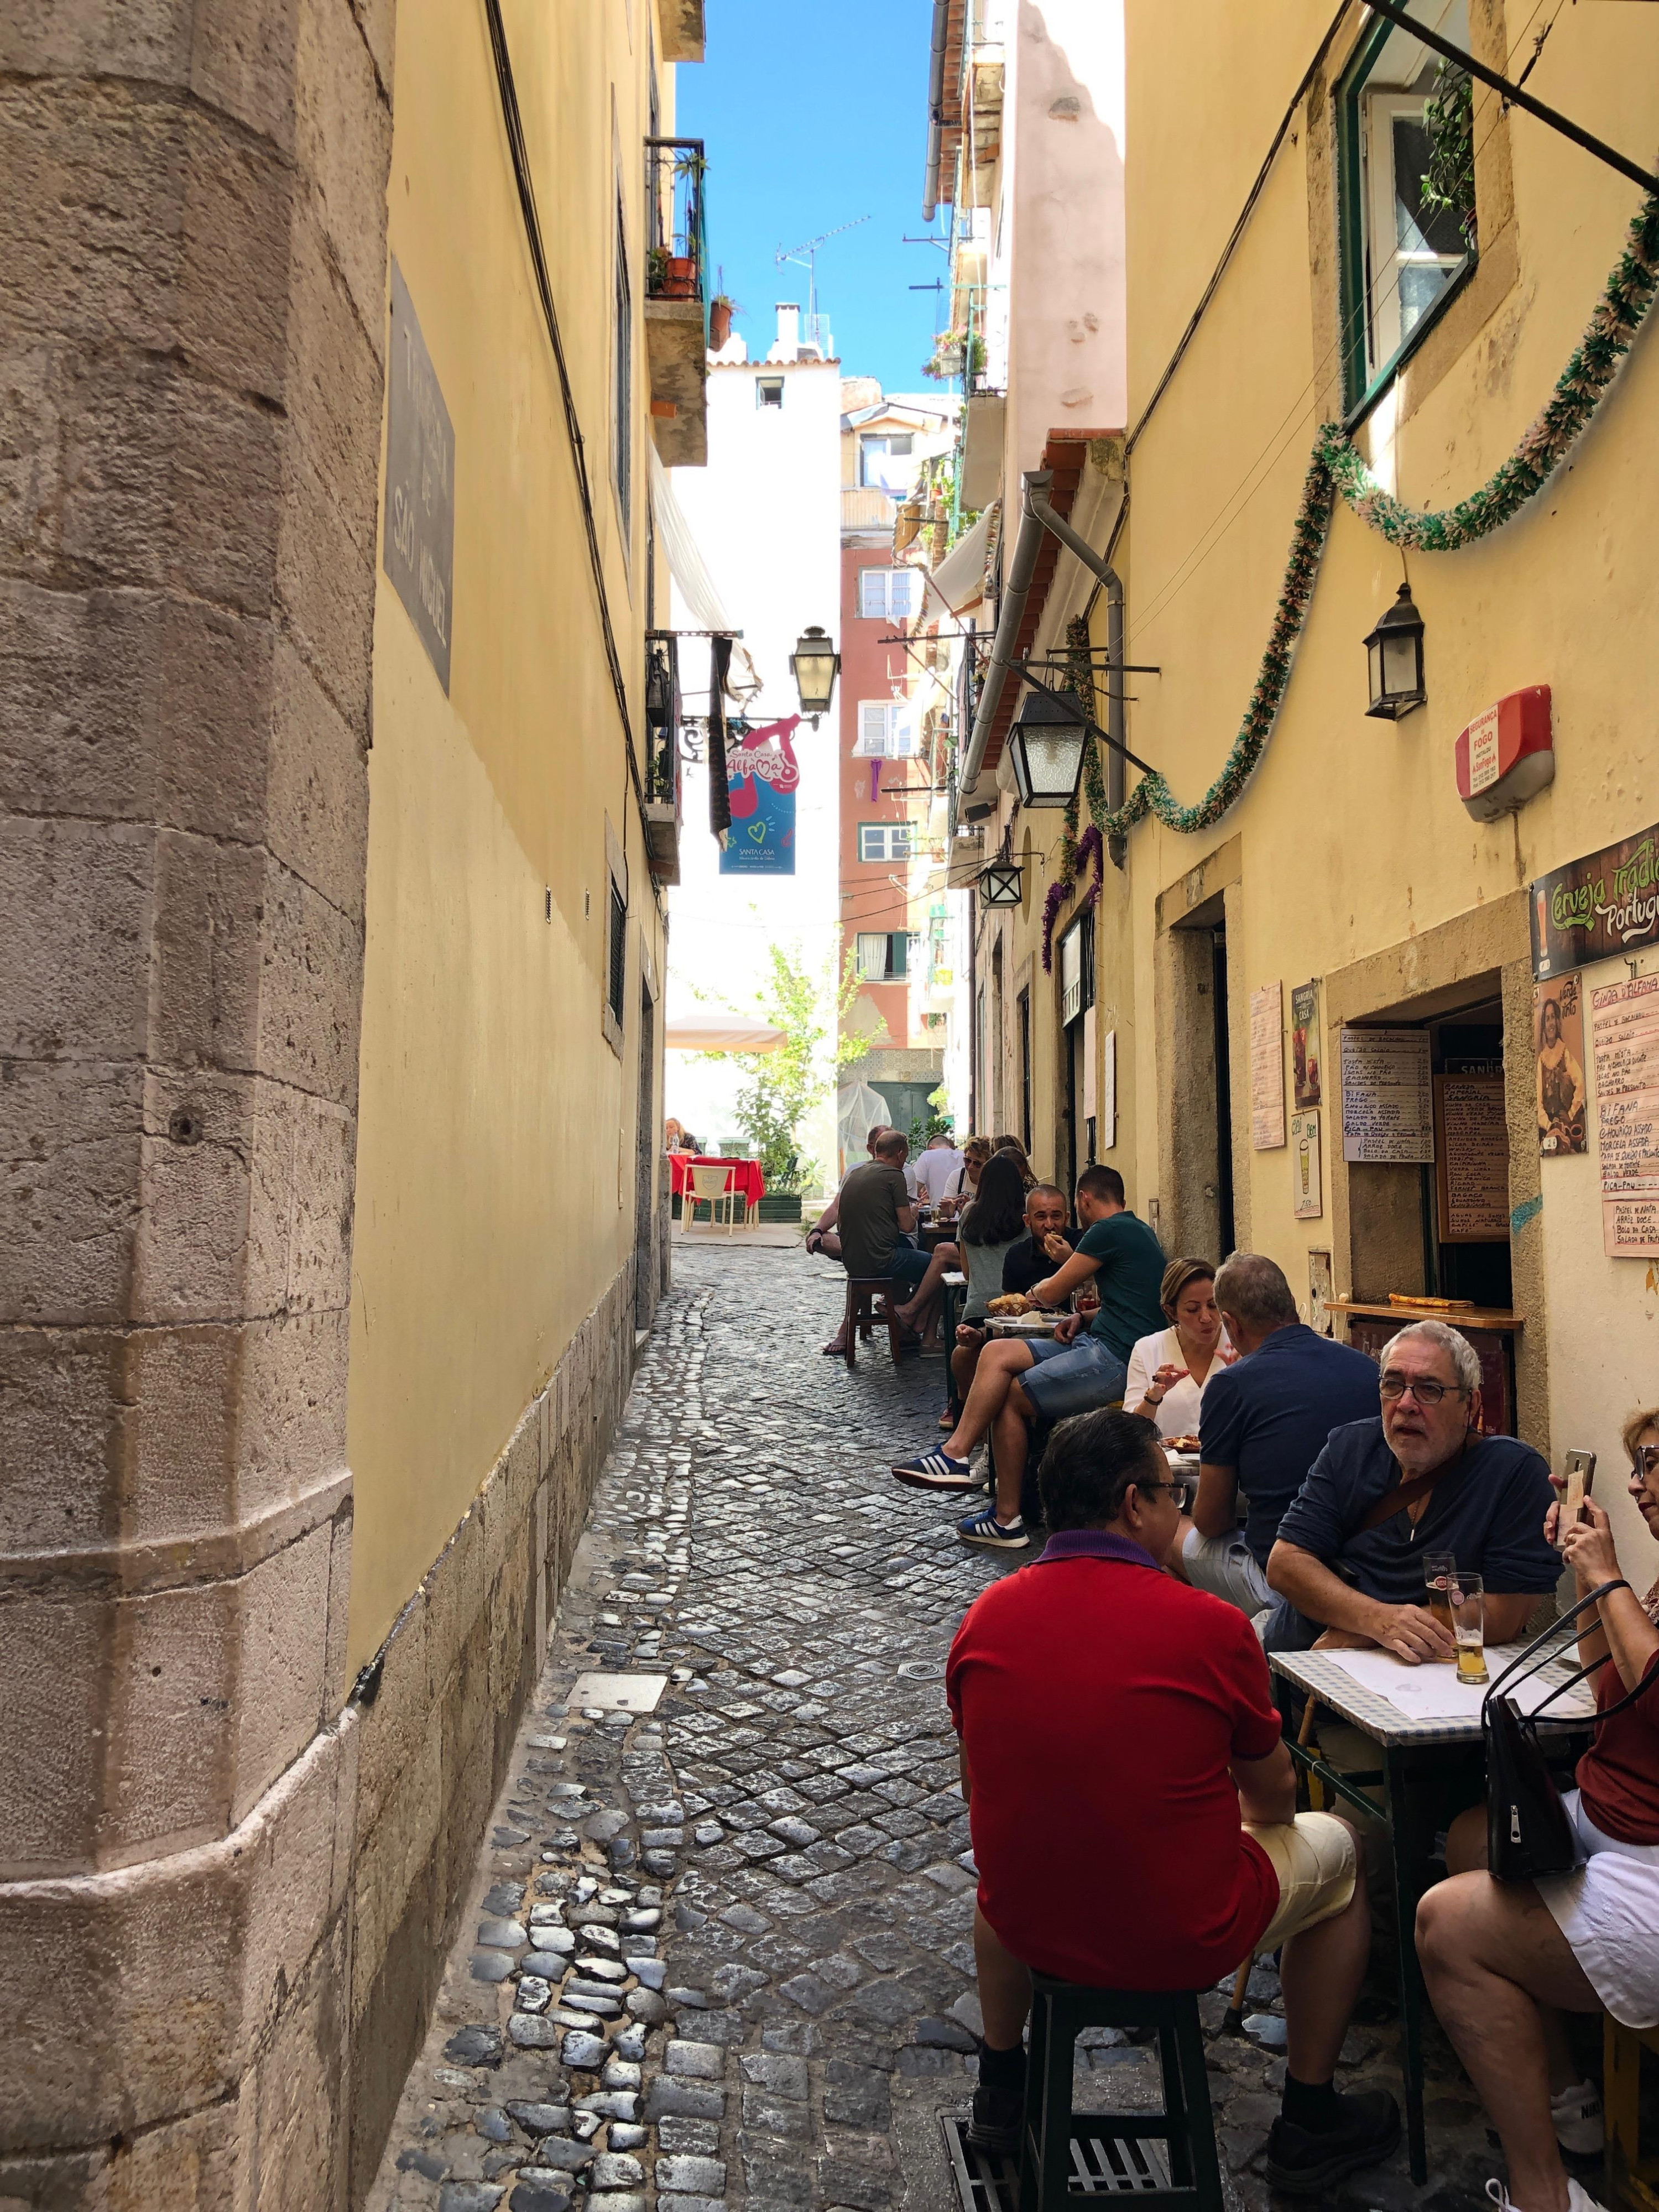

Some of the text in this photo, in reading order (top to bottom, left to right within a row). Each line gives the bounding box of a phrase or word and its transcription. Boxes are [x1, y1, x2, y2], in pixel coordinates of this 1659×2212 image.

[394, 481, 447, 649] SÃO MIGUEL
[1469, 709, 1498, 734] SEGURANÇA
[1474, 731, 1493, 750] FOGO
[730, 750, 772, 758] Santa Casa
[1551, 872, 1606, 932] Cerveja
[1295, 989, 1313, 1004] SANGRIA
[1299, 1008, 1310, 1021] CASA
[1598, 1078, 1625, 1089] CACHORRO
[1601, 1115, 1625, 1127] PREGO
[1634, 1123, 1652, 1136] ASSADO
[1600, 1136, 1649, 1151] MORCELA ASSADA
[1640, 1203, 1656, 1214] NATA
[1636, 1215, 1652, 1224] DOCE
[1641, 1225, 1656, 1234] CASA
